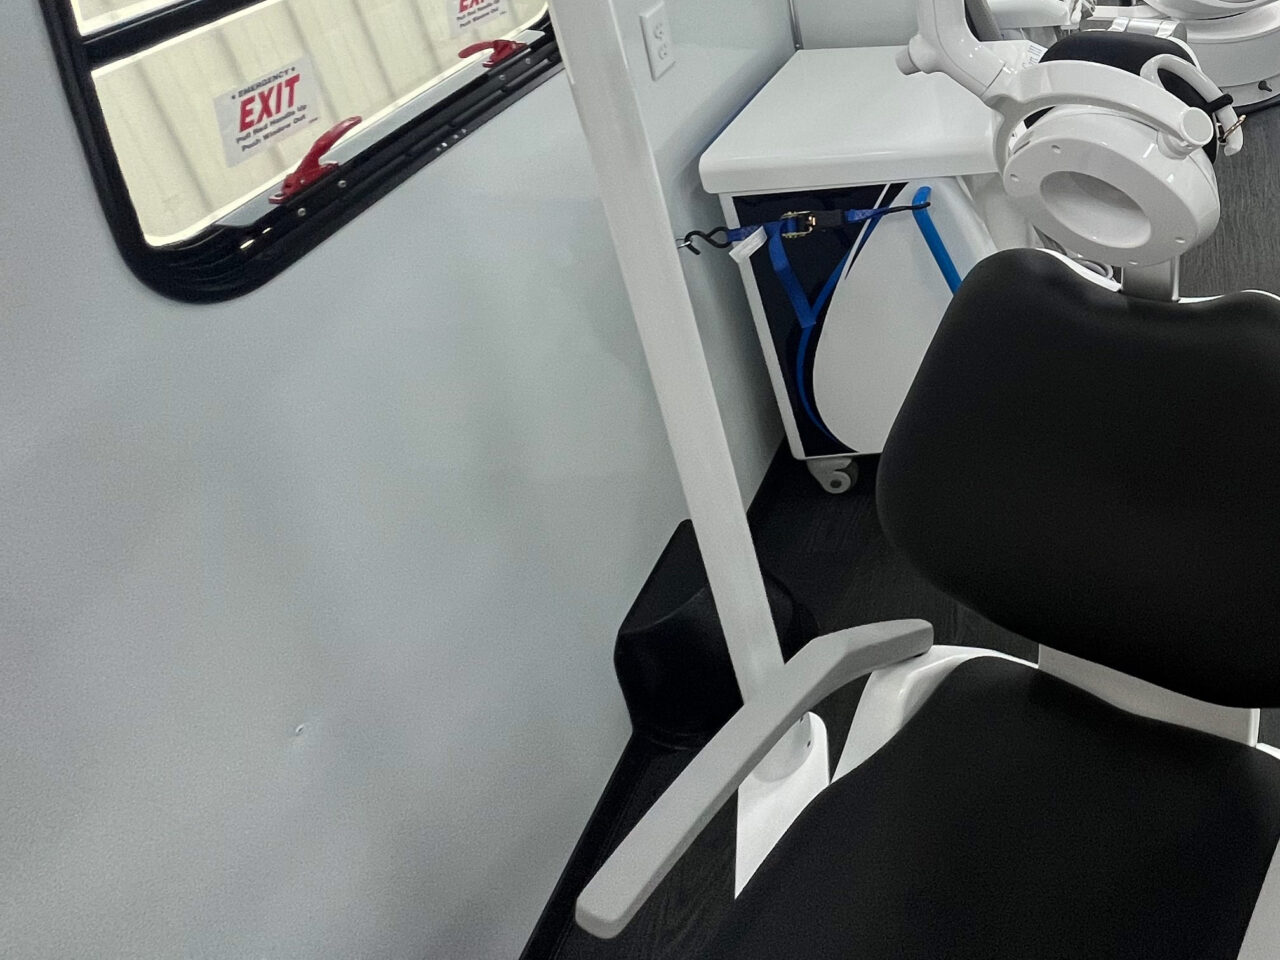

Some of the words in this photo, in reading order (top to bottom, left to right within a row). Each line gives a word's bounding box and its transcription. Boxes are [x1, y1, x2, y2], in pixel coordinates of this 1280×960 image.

[238, 68, 289, 98] EMERGENCY
[239, 73, 300, 133] EXIT
[241, 138, 261, 152] Push
